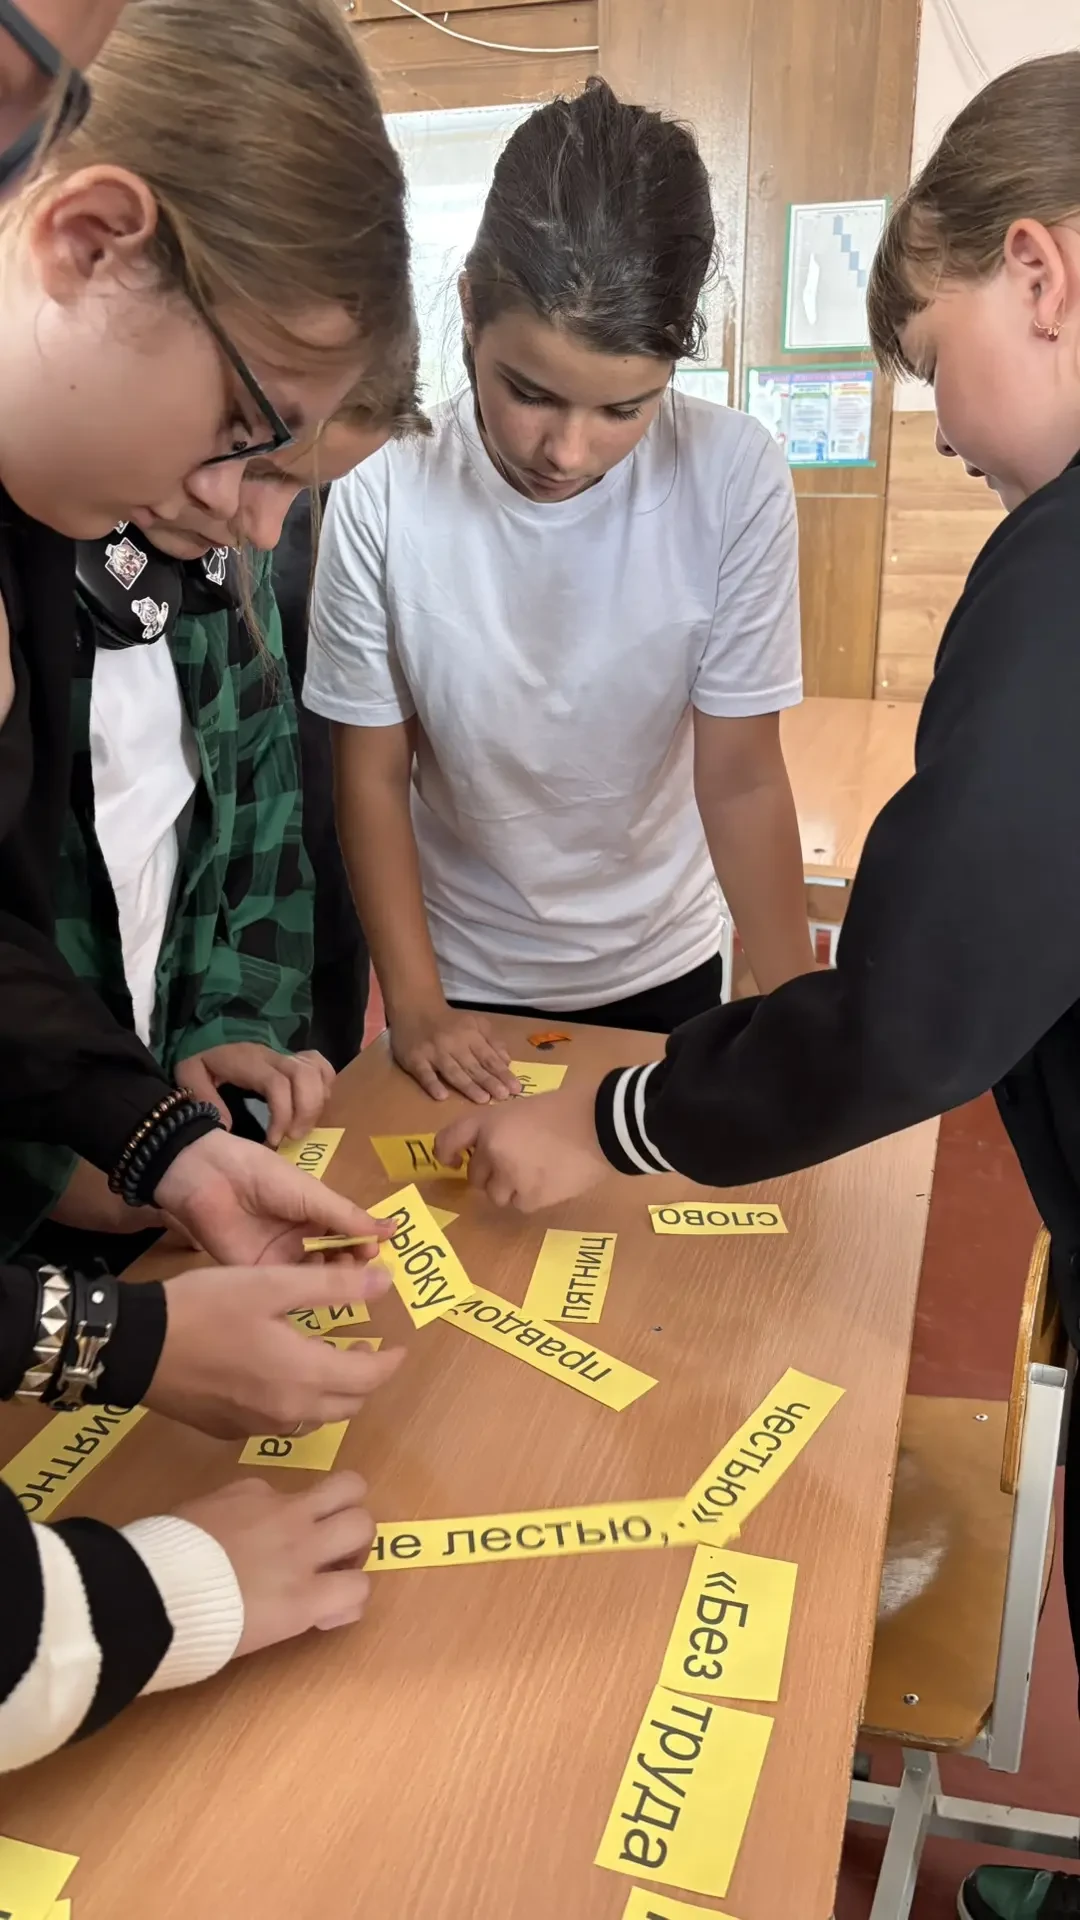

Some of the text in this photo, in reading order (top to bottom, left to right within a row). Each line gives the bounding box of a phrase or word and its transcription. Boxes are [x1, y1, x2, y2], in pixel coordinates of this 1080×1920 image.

[387, 1206, 456, 1310] рыбку
[658, 1208, 778, 1227] слово
[450, 1298, 612, 1382] правдой
[442, 1515, 669, 1557] лестью,
[683, 1570, 749, 1681] «Без
[618, 1706, 714, 1869] труда
